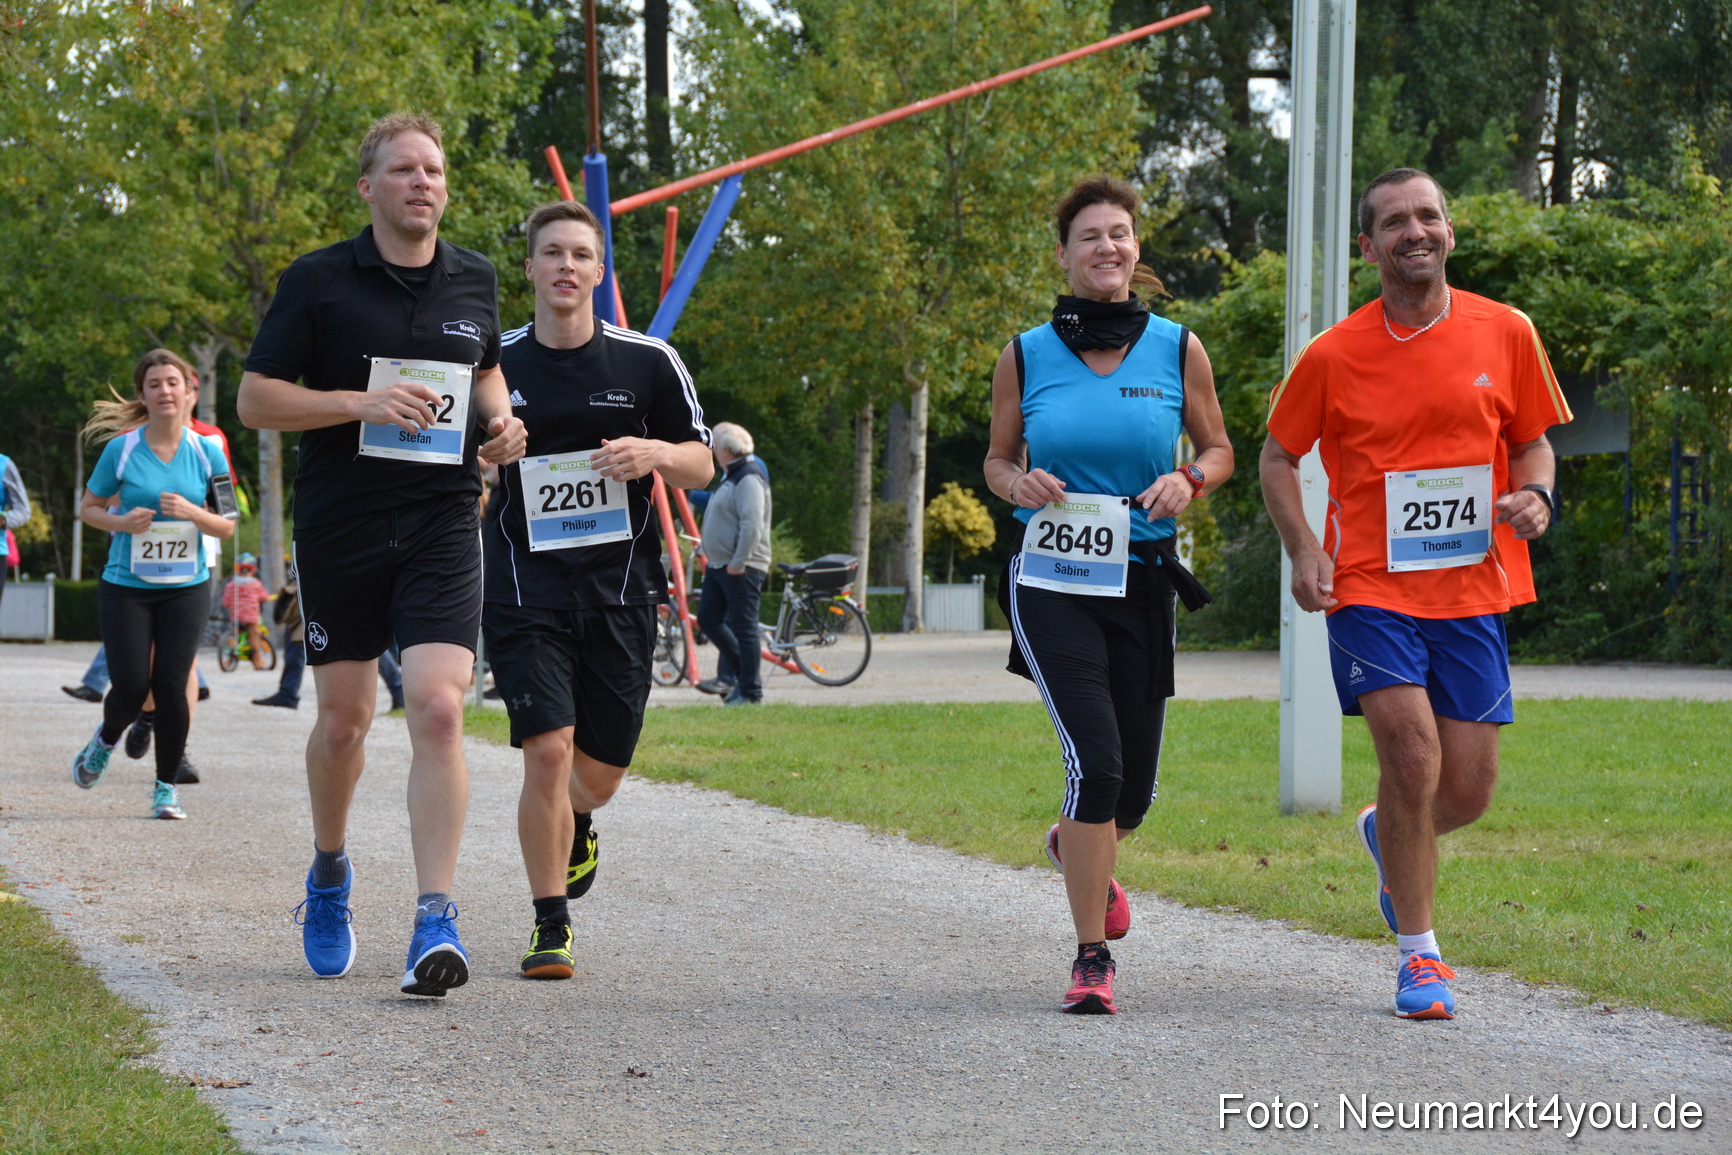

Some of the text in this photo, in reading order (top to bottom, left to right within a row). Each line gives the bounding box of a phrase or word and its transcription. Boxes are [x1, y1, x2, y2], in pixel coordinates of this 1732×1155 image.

[410, 369, 445, 379] BOCK
[607, 393, 627, 401] Krebs
[1119, 387, 1162, 398] THULE
[399, 430, 431, 443] Stefan
[560, 460, 592, 470] BOCK
[1428, 476, 1463, 487] BOCK
[539, 478, 607, 512] 2261
[1064, 502, 1100, 512] BOCK
[1403, 496, 1476, 530] 2574
[562, 519, 596, 531] Philipp
[1037, 520, 1113, 556] 2649
[142, 541, 187, 558] 2172
[1421, 540, 1461, 551] Thomas
[1054, 562, 1089, 576] Sabine
